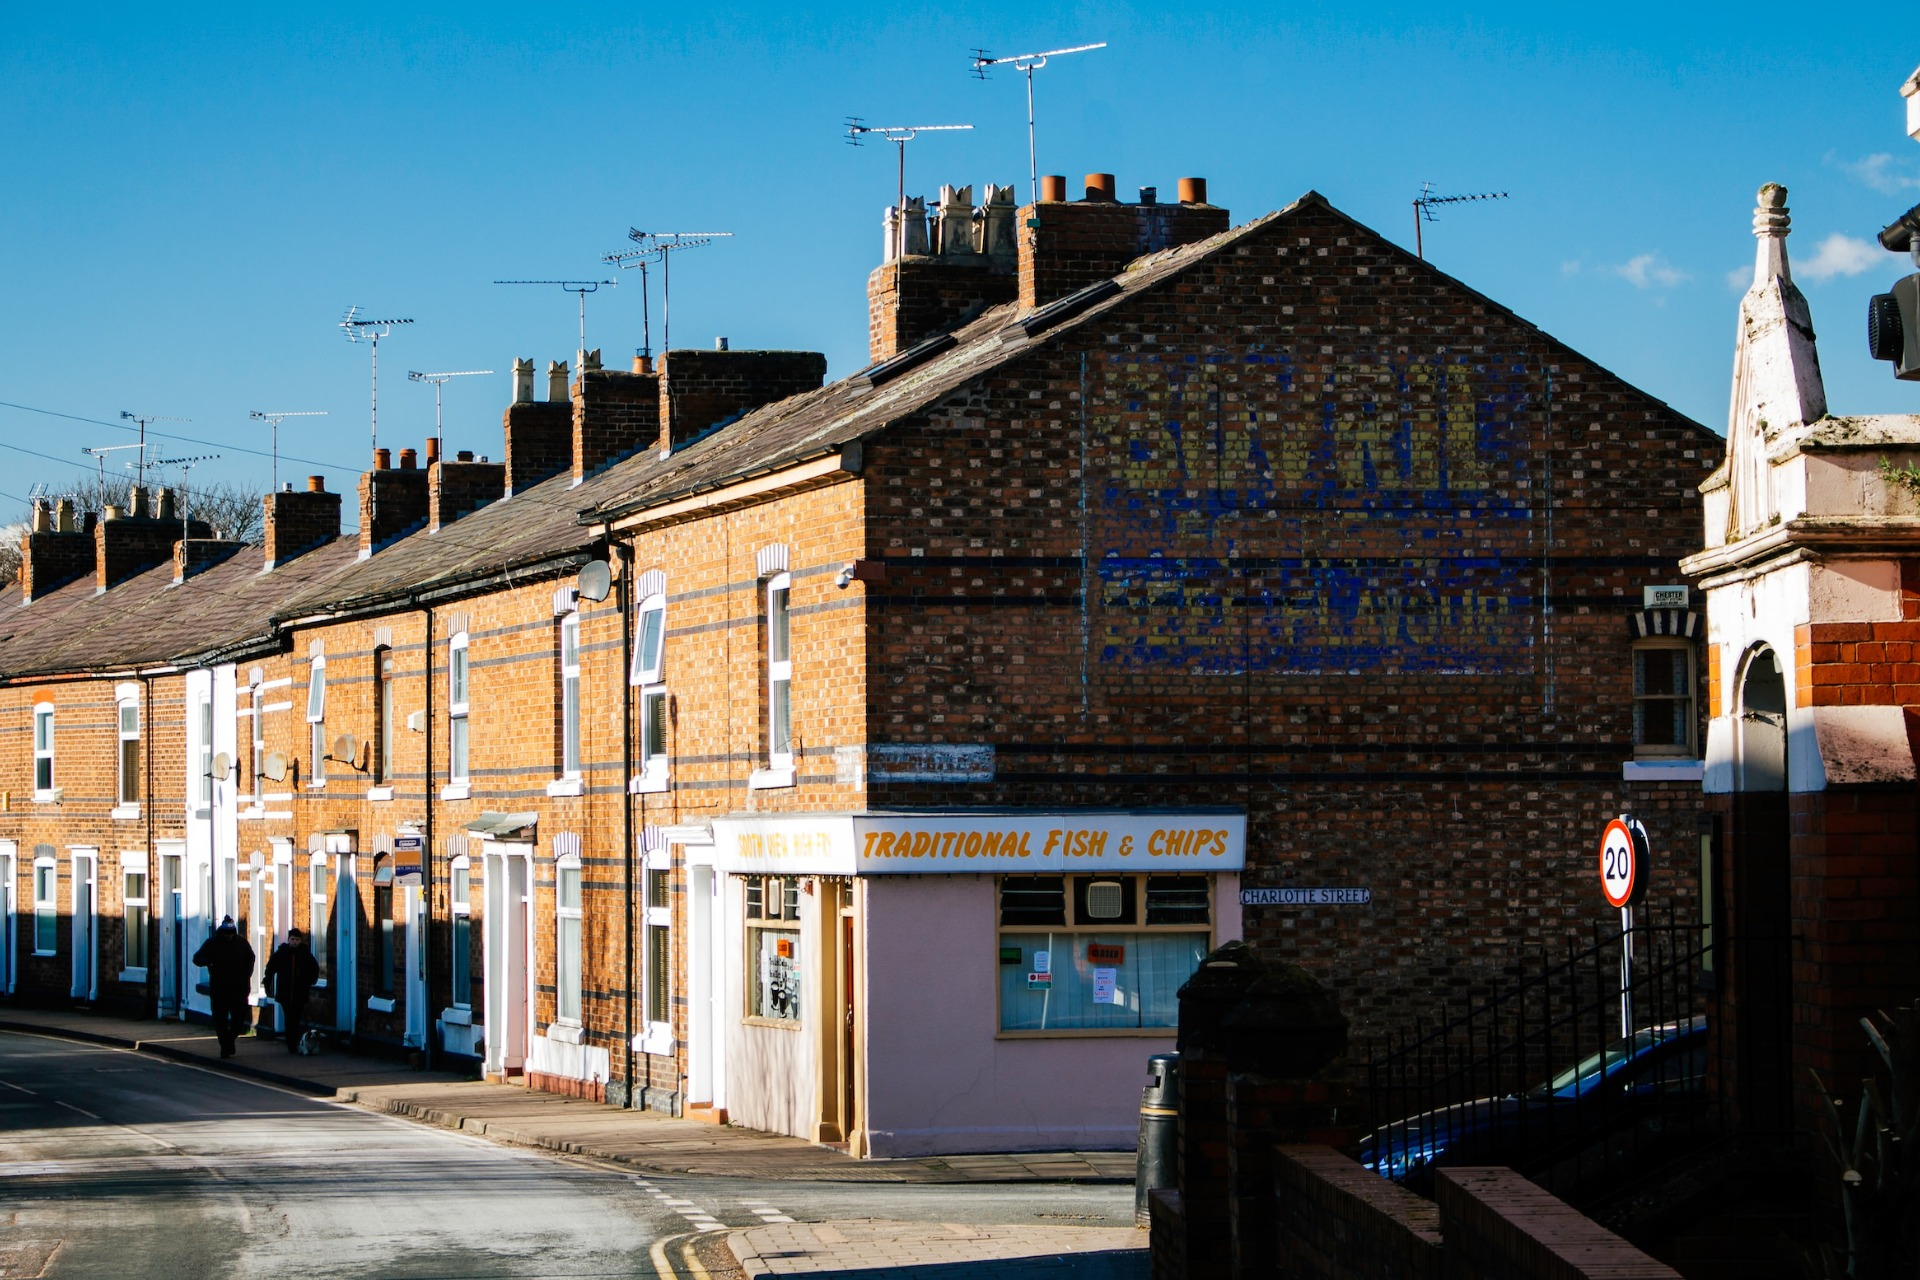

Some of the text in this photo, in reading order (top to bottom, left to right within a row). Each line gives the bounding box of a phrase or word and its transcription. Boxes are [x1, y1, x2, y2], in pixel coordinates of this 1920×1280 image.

[863, 829, 1229, 858] TRADITIONAL FISH & CHIPS
[1605, 846, 1629, 880] 20
[1243, 889, 1366, 903] CHARLOTTE STREET
[1092, 949, 1119, 959] CLOSED
